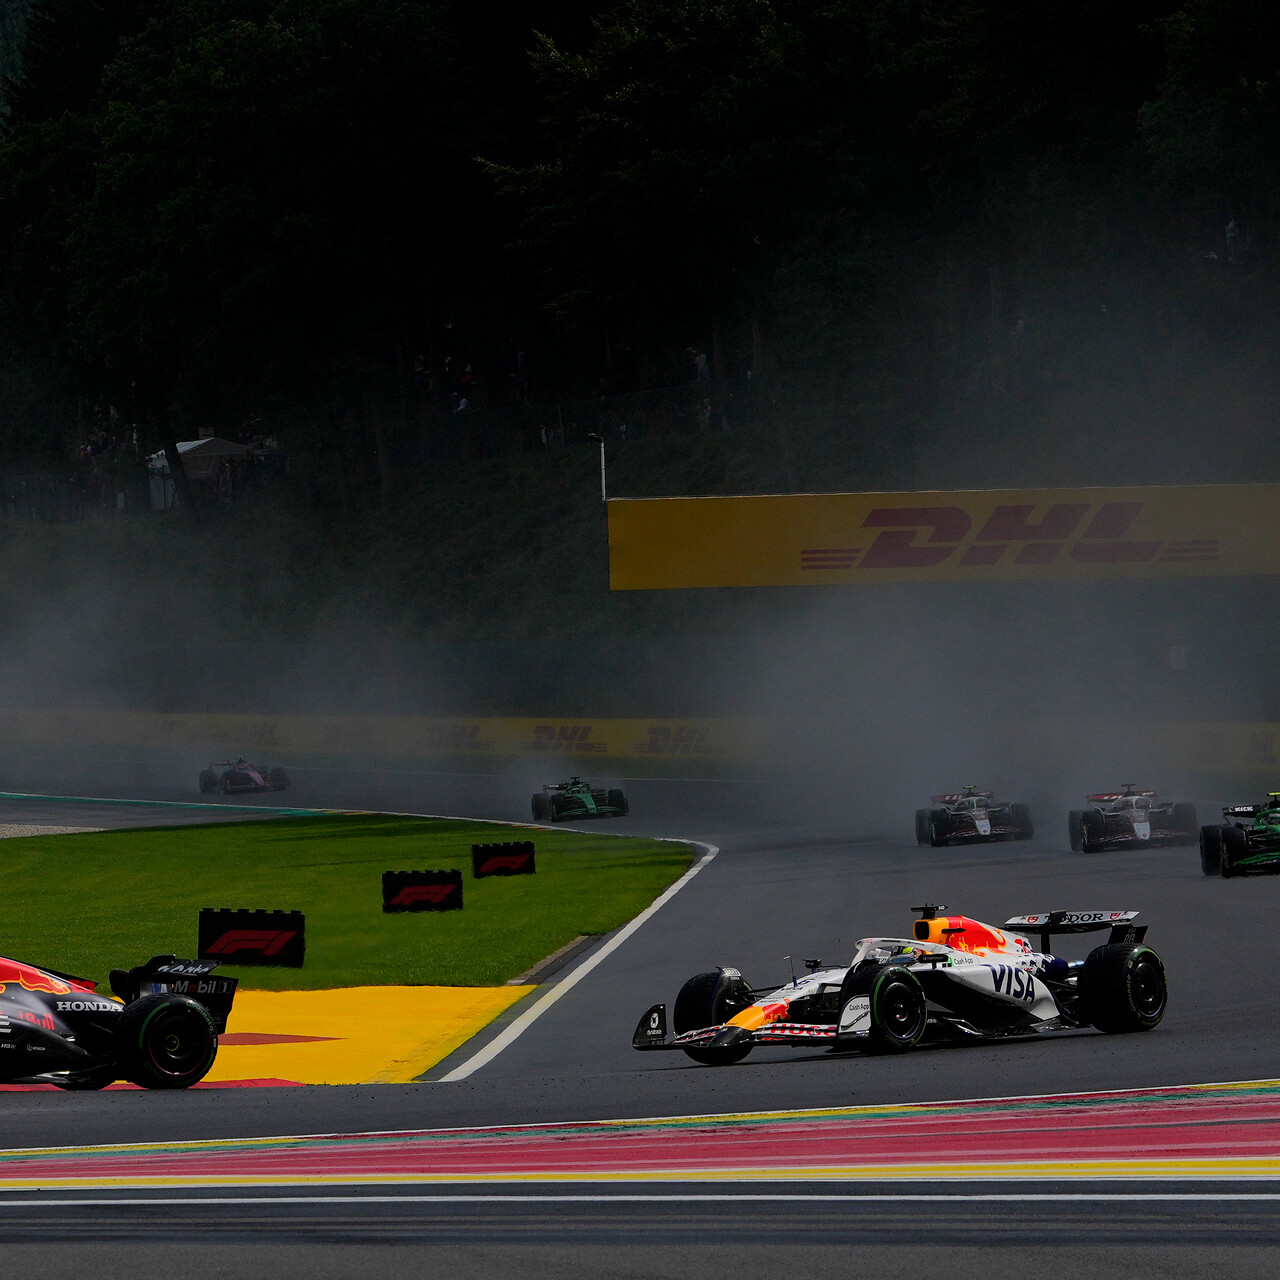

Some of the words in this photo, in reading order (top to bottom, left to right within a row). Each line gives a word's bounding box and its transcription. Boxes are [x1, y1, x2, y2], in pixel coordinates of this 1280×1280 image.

[857, 502, 1166, 568] DHL
[532, 725, 596, 752] DHL
[1044, 912, 1104, 922] TDOR
[174, 980, 217, 994] Mobil
[989, 964, 1035, 1005] VISA
[56, 1001, 125, 1012] HONDA
